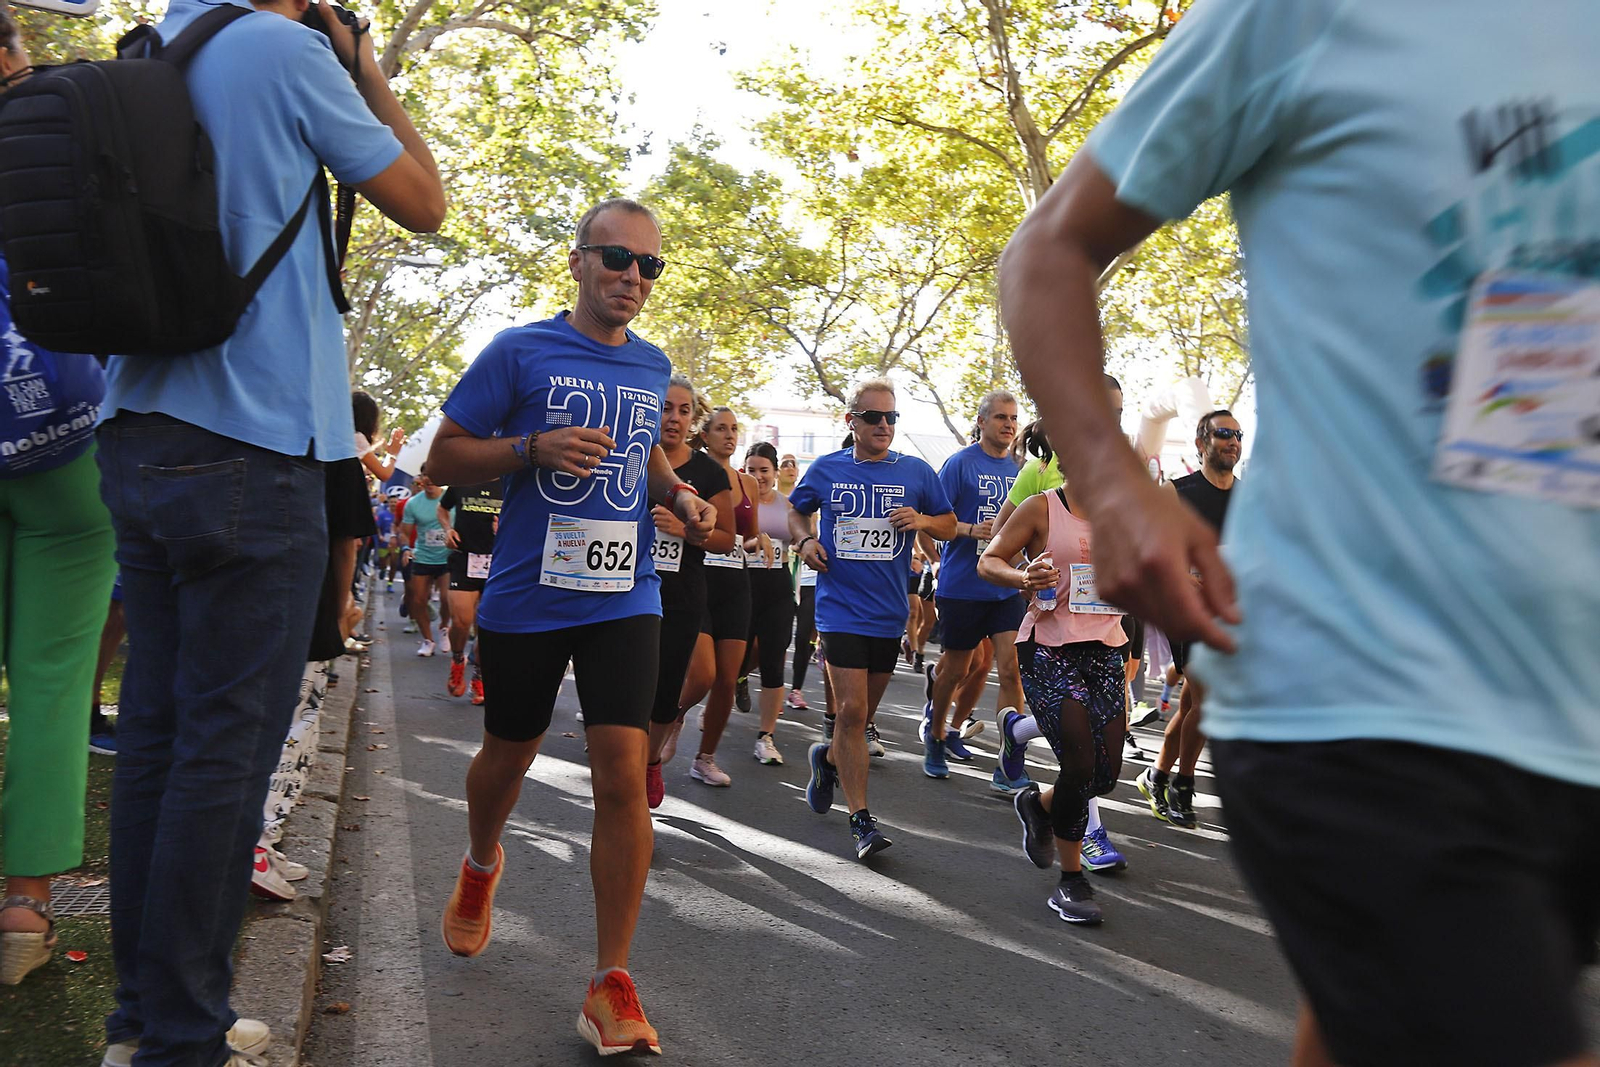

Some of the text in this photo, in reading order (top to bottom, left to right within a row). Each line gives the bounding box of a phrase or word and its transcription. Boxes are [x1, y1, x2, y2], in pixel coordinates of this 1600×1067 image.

[549, 376, 605, 392] VUELTA A
[622, 391, 658, 406] 12/10/22
[563, 539, 586, 547] HUELVA
[860, 529, 891, 548] 732
[587, 540, 633, 571] 652
